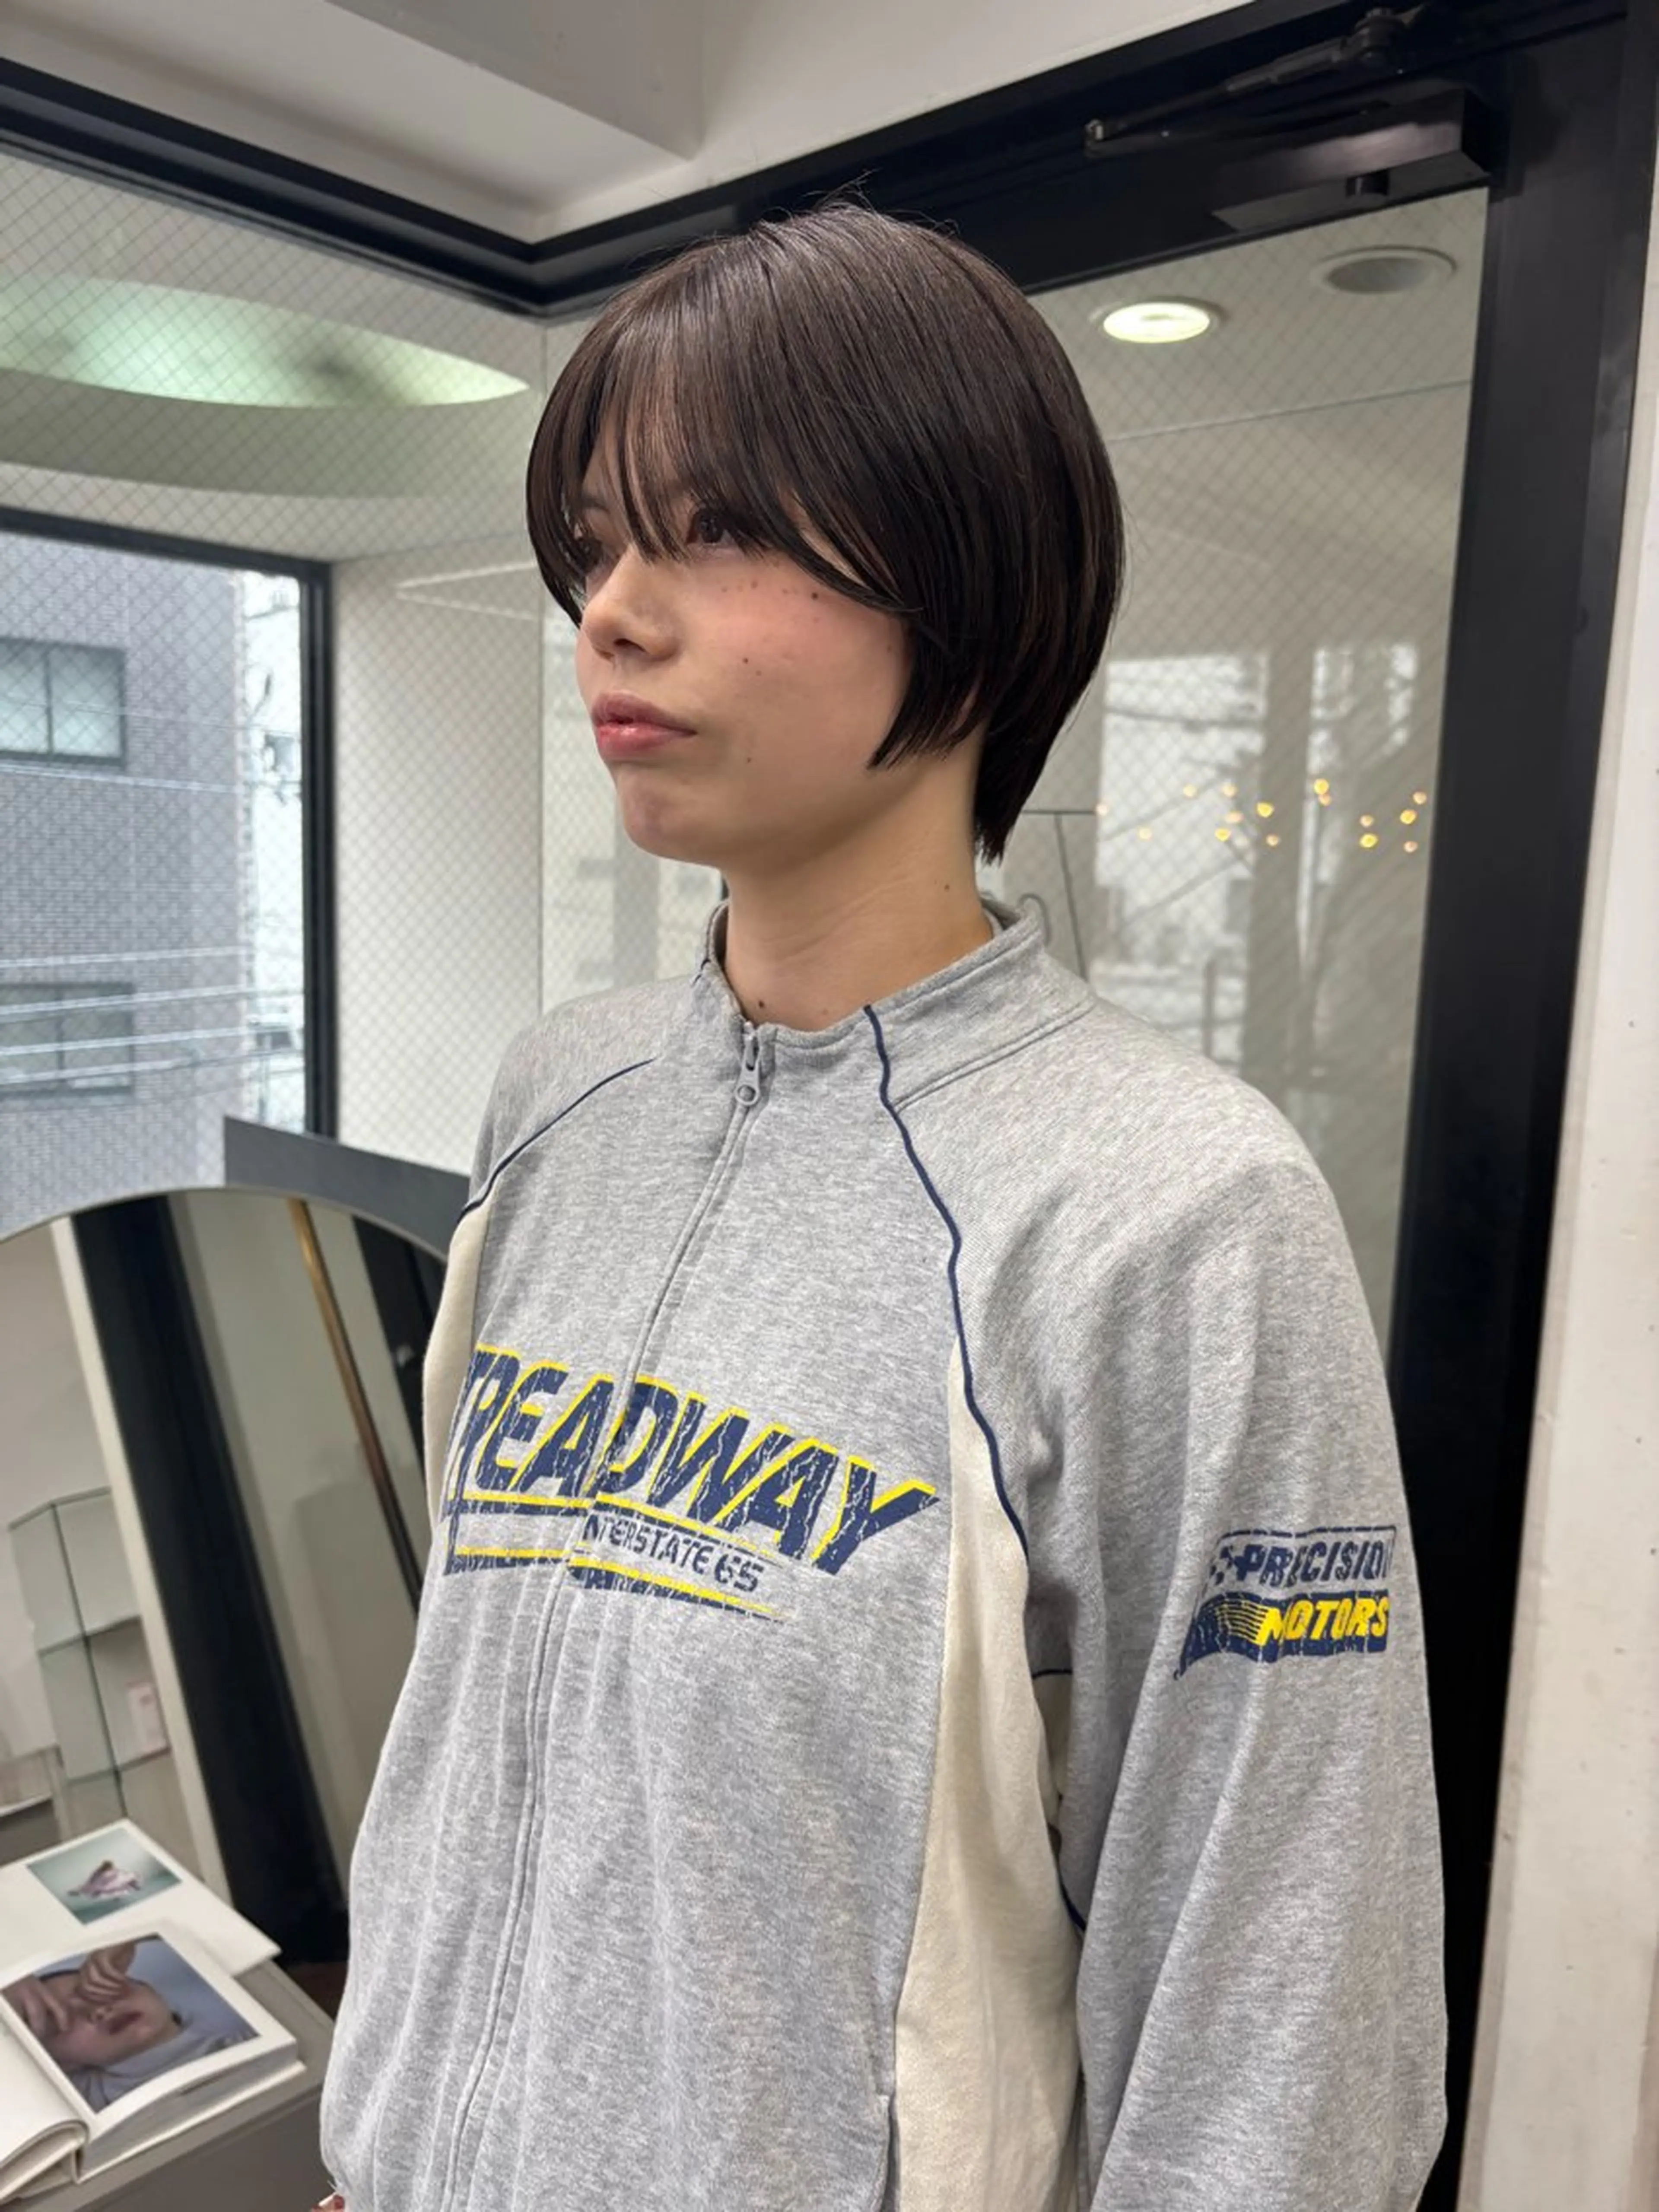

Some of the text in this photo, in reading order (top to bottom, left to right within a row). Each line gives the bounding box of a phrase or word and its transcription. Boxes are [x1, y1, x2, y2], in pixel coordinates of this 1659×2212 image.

[583, 1514, 765, 1592] NTERSTATE 65
[1255, 1597, 1390, 1646] MOTORS
